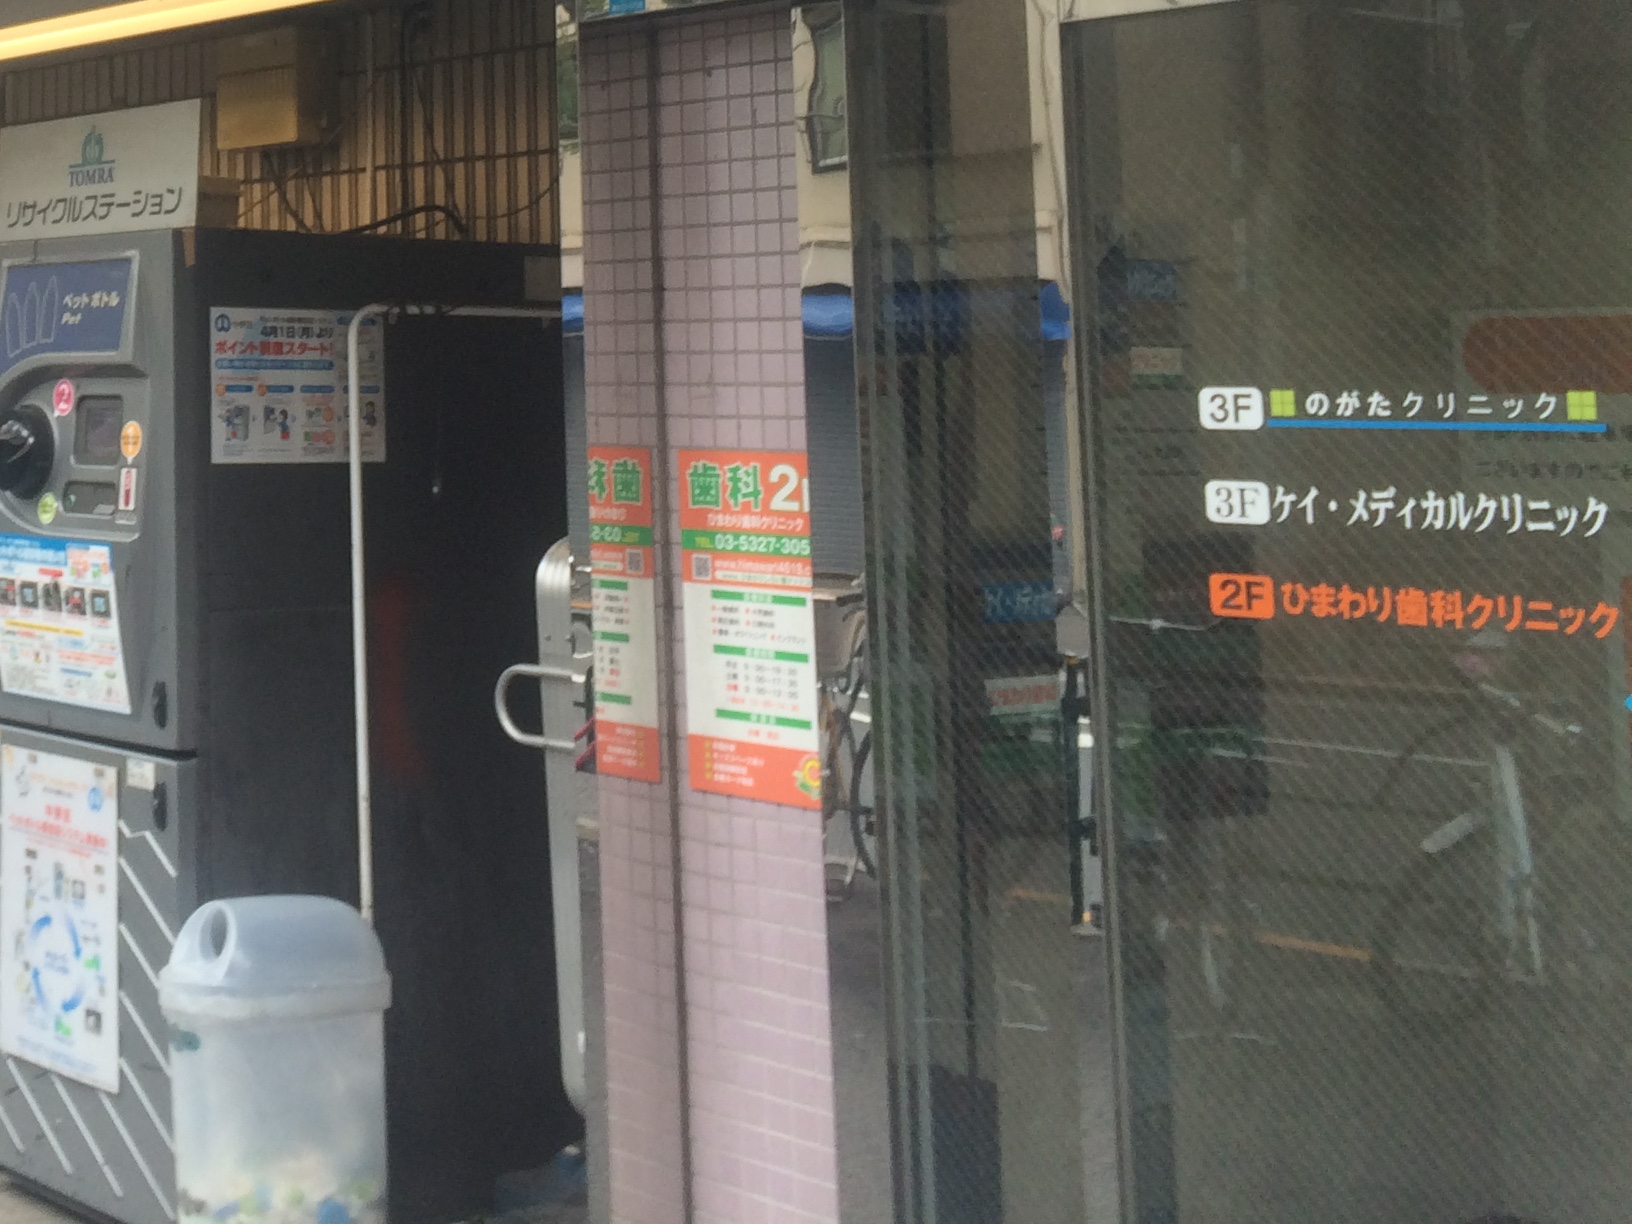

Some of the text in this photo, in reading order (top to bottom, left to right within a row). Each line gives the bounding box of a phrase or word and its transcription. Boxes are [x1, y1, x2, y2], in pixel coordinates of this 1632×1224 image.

[68, 166, 116, 188] TOMRA
[6, 187, 184, 228] リサイクルステーション
[1209, 392, 1558, 424] 3F のがたクリニック
[686, 459, 764, 512] 歯科
[1214, 484, 1610, 538] 3F ケイ・メディカルクリニック
[1218, 580, 1620, 639] 2F ひまわり歯科クリニック
